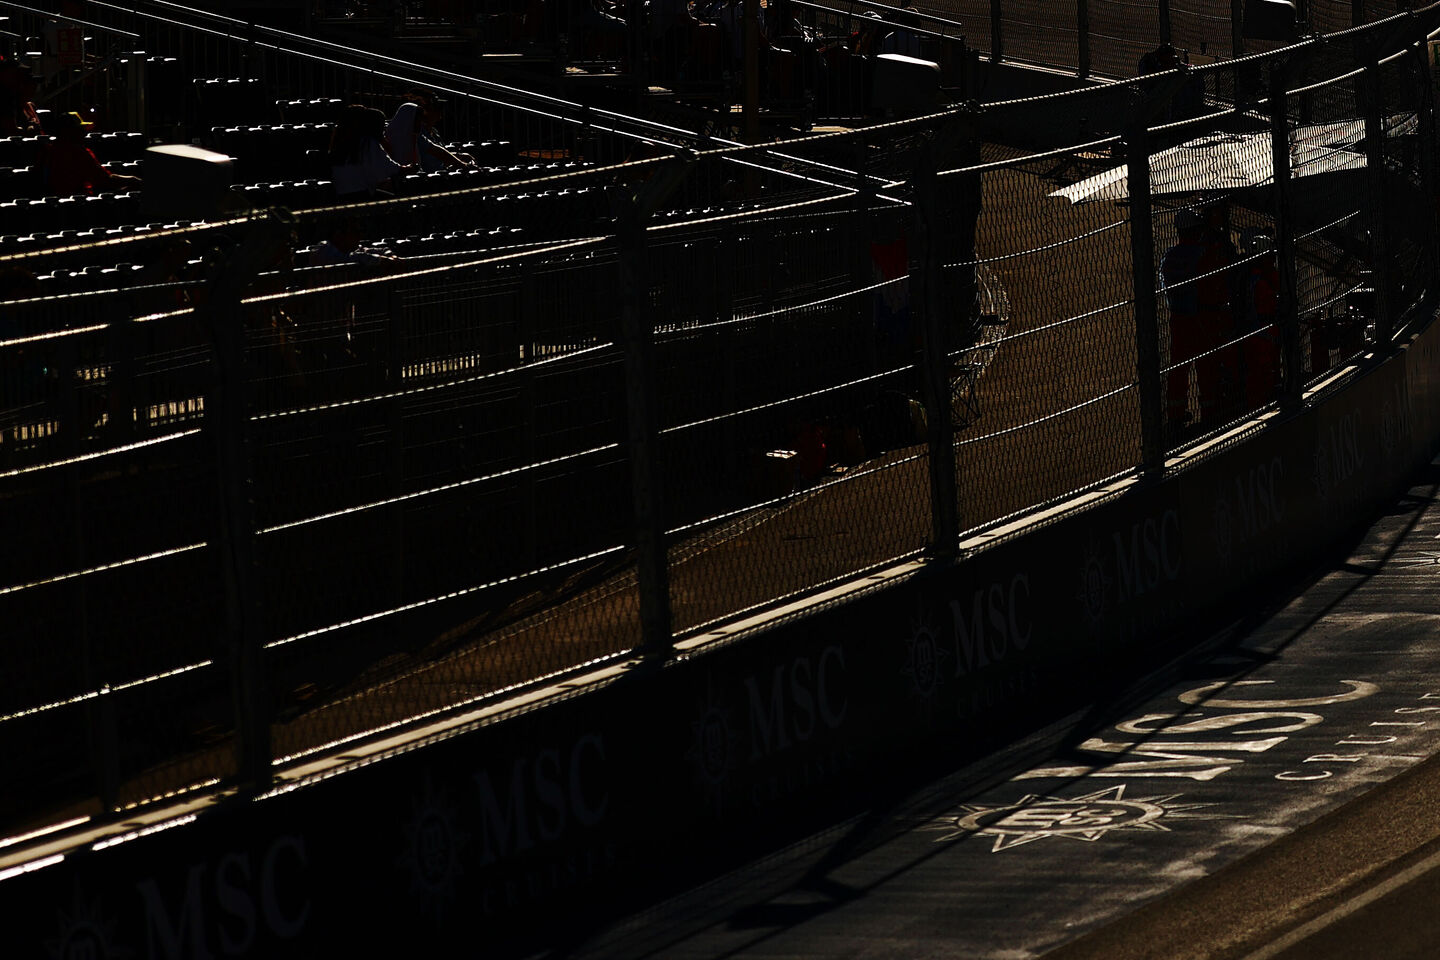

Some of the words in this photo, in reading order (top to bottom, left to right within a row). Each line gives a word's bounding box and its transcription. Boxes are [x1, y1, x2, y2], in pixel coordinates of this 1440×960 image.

[1235, 456, 1287, 546] MSC
[1112, 508, 1183, 603] MSC
[949, 571, 1032, 678] MSC
[744, 642, 848, 767] MSC
[1009, 679, 1382, 782] MSC
[472, 732, 608, 868] MSC
[136, 833, 312, 960] MSC
